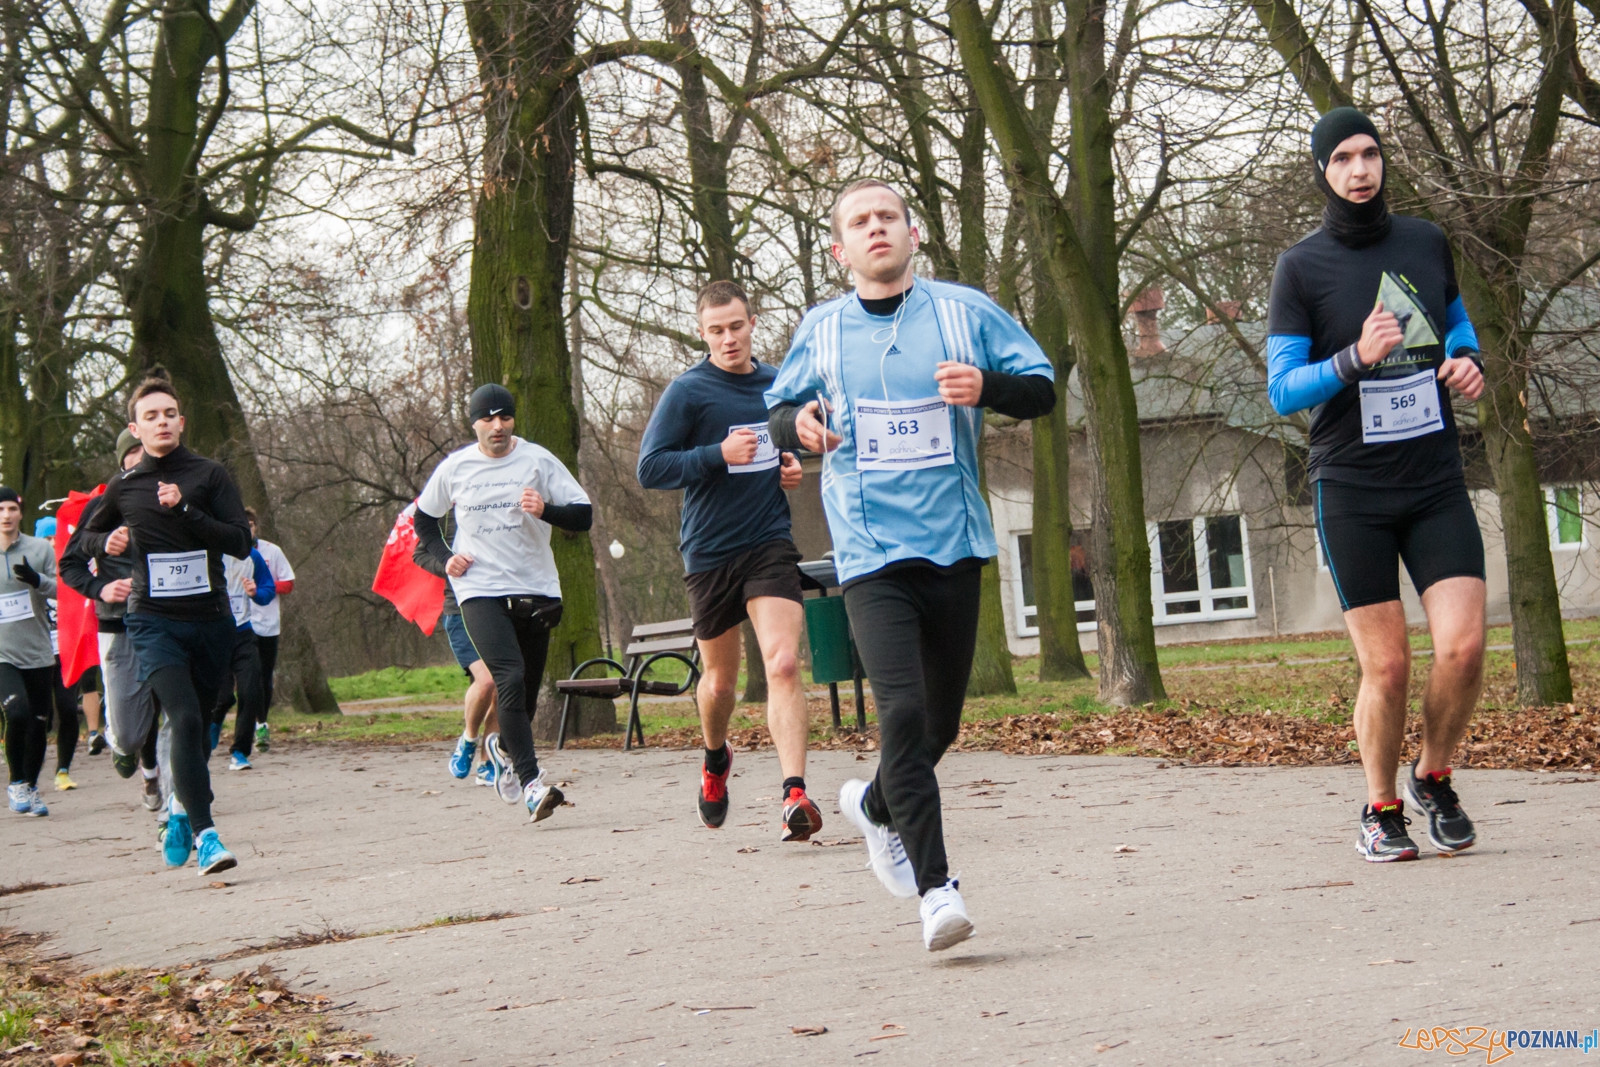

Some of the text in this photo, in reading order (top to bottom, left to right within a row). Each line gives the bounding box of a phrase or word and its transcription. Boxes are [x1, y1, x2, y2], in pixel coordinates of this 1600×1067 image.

[1390, 393, 1416, 410] 569
[887, 420, 919, 435] 363
[758, 434, 768, 445] 90
[464, 501, 521, 512] DruzynaJezus
[169, 565, 188, 575] 797
